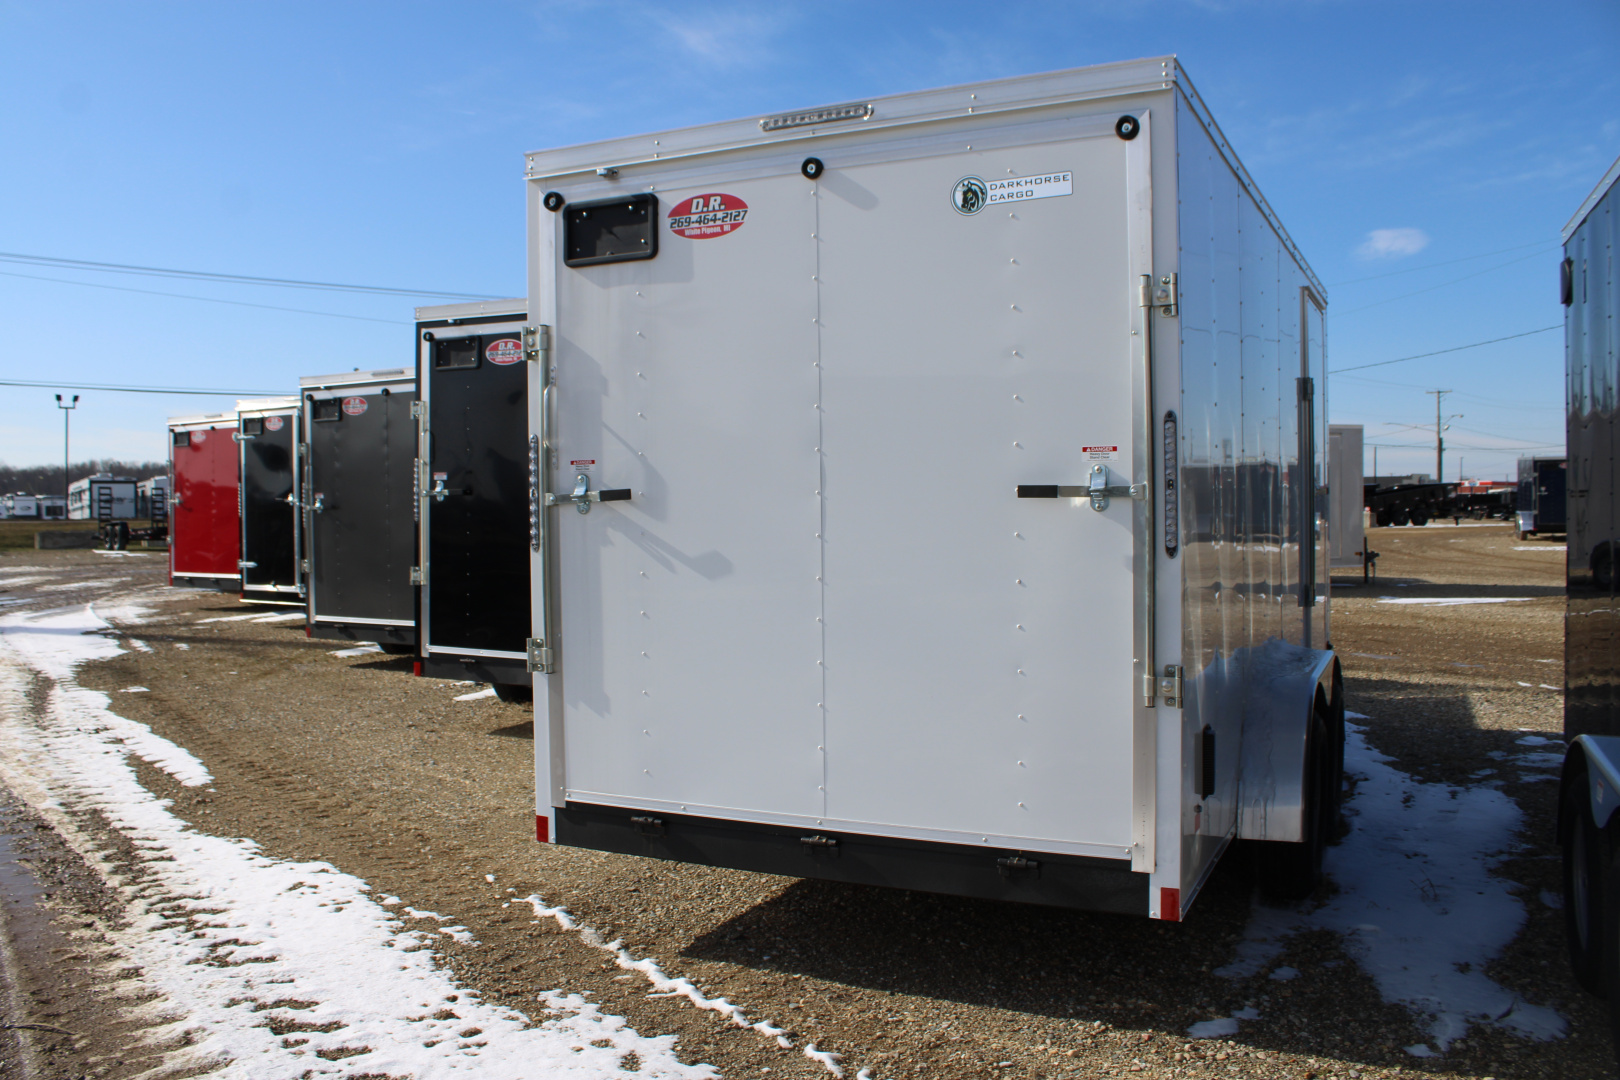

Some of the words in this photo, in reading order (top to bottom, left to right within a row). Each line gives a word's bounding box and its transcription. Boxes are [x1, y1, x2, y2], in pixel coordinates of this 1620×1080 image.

[989, 173, 1070, 190] DARKHORSE
[690, 194, 726, 214] D.R.
[990, 189, 1034, 202] CARGO
[669, 209, 749, 229] 269-464-2127
[498, 341, 516, 350] D.R.
